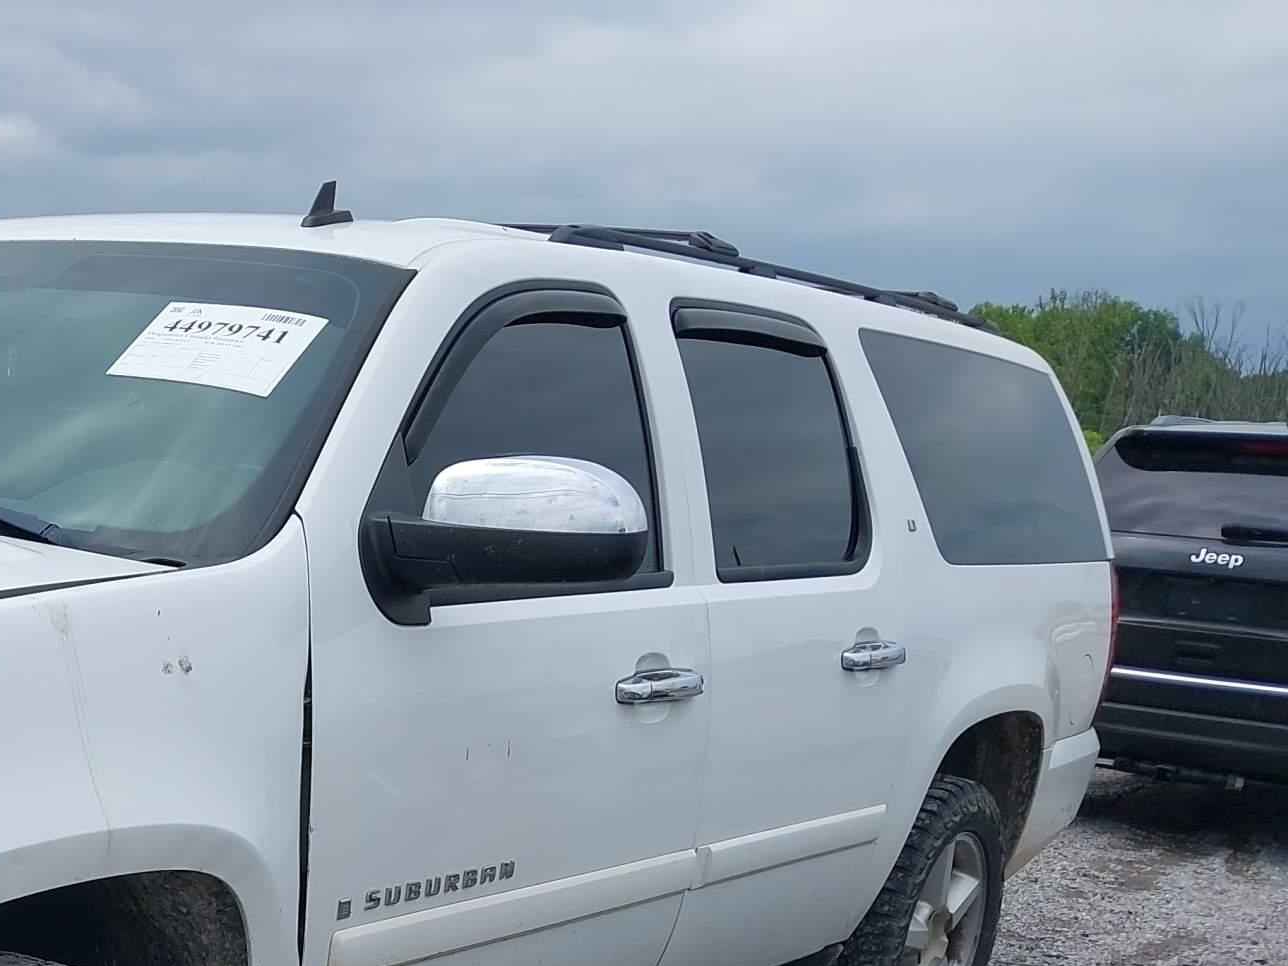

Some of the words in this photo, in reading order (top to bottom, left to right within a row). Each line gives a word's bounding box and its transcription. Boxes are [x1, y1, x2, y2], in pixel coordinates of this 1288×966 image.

[163, 318, 290, 345] 44979741
[1190, 548, 1244, 569] Jeep
[364, 860, 516, 911] SUBURBAN
